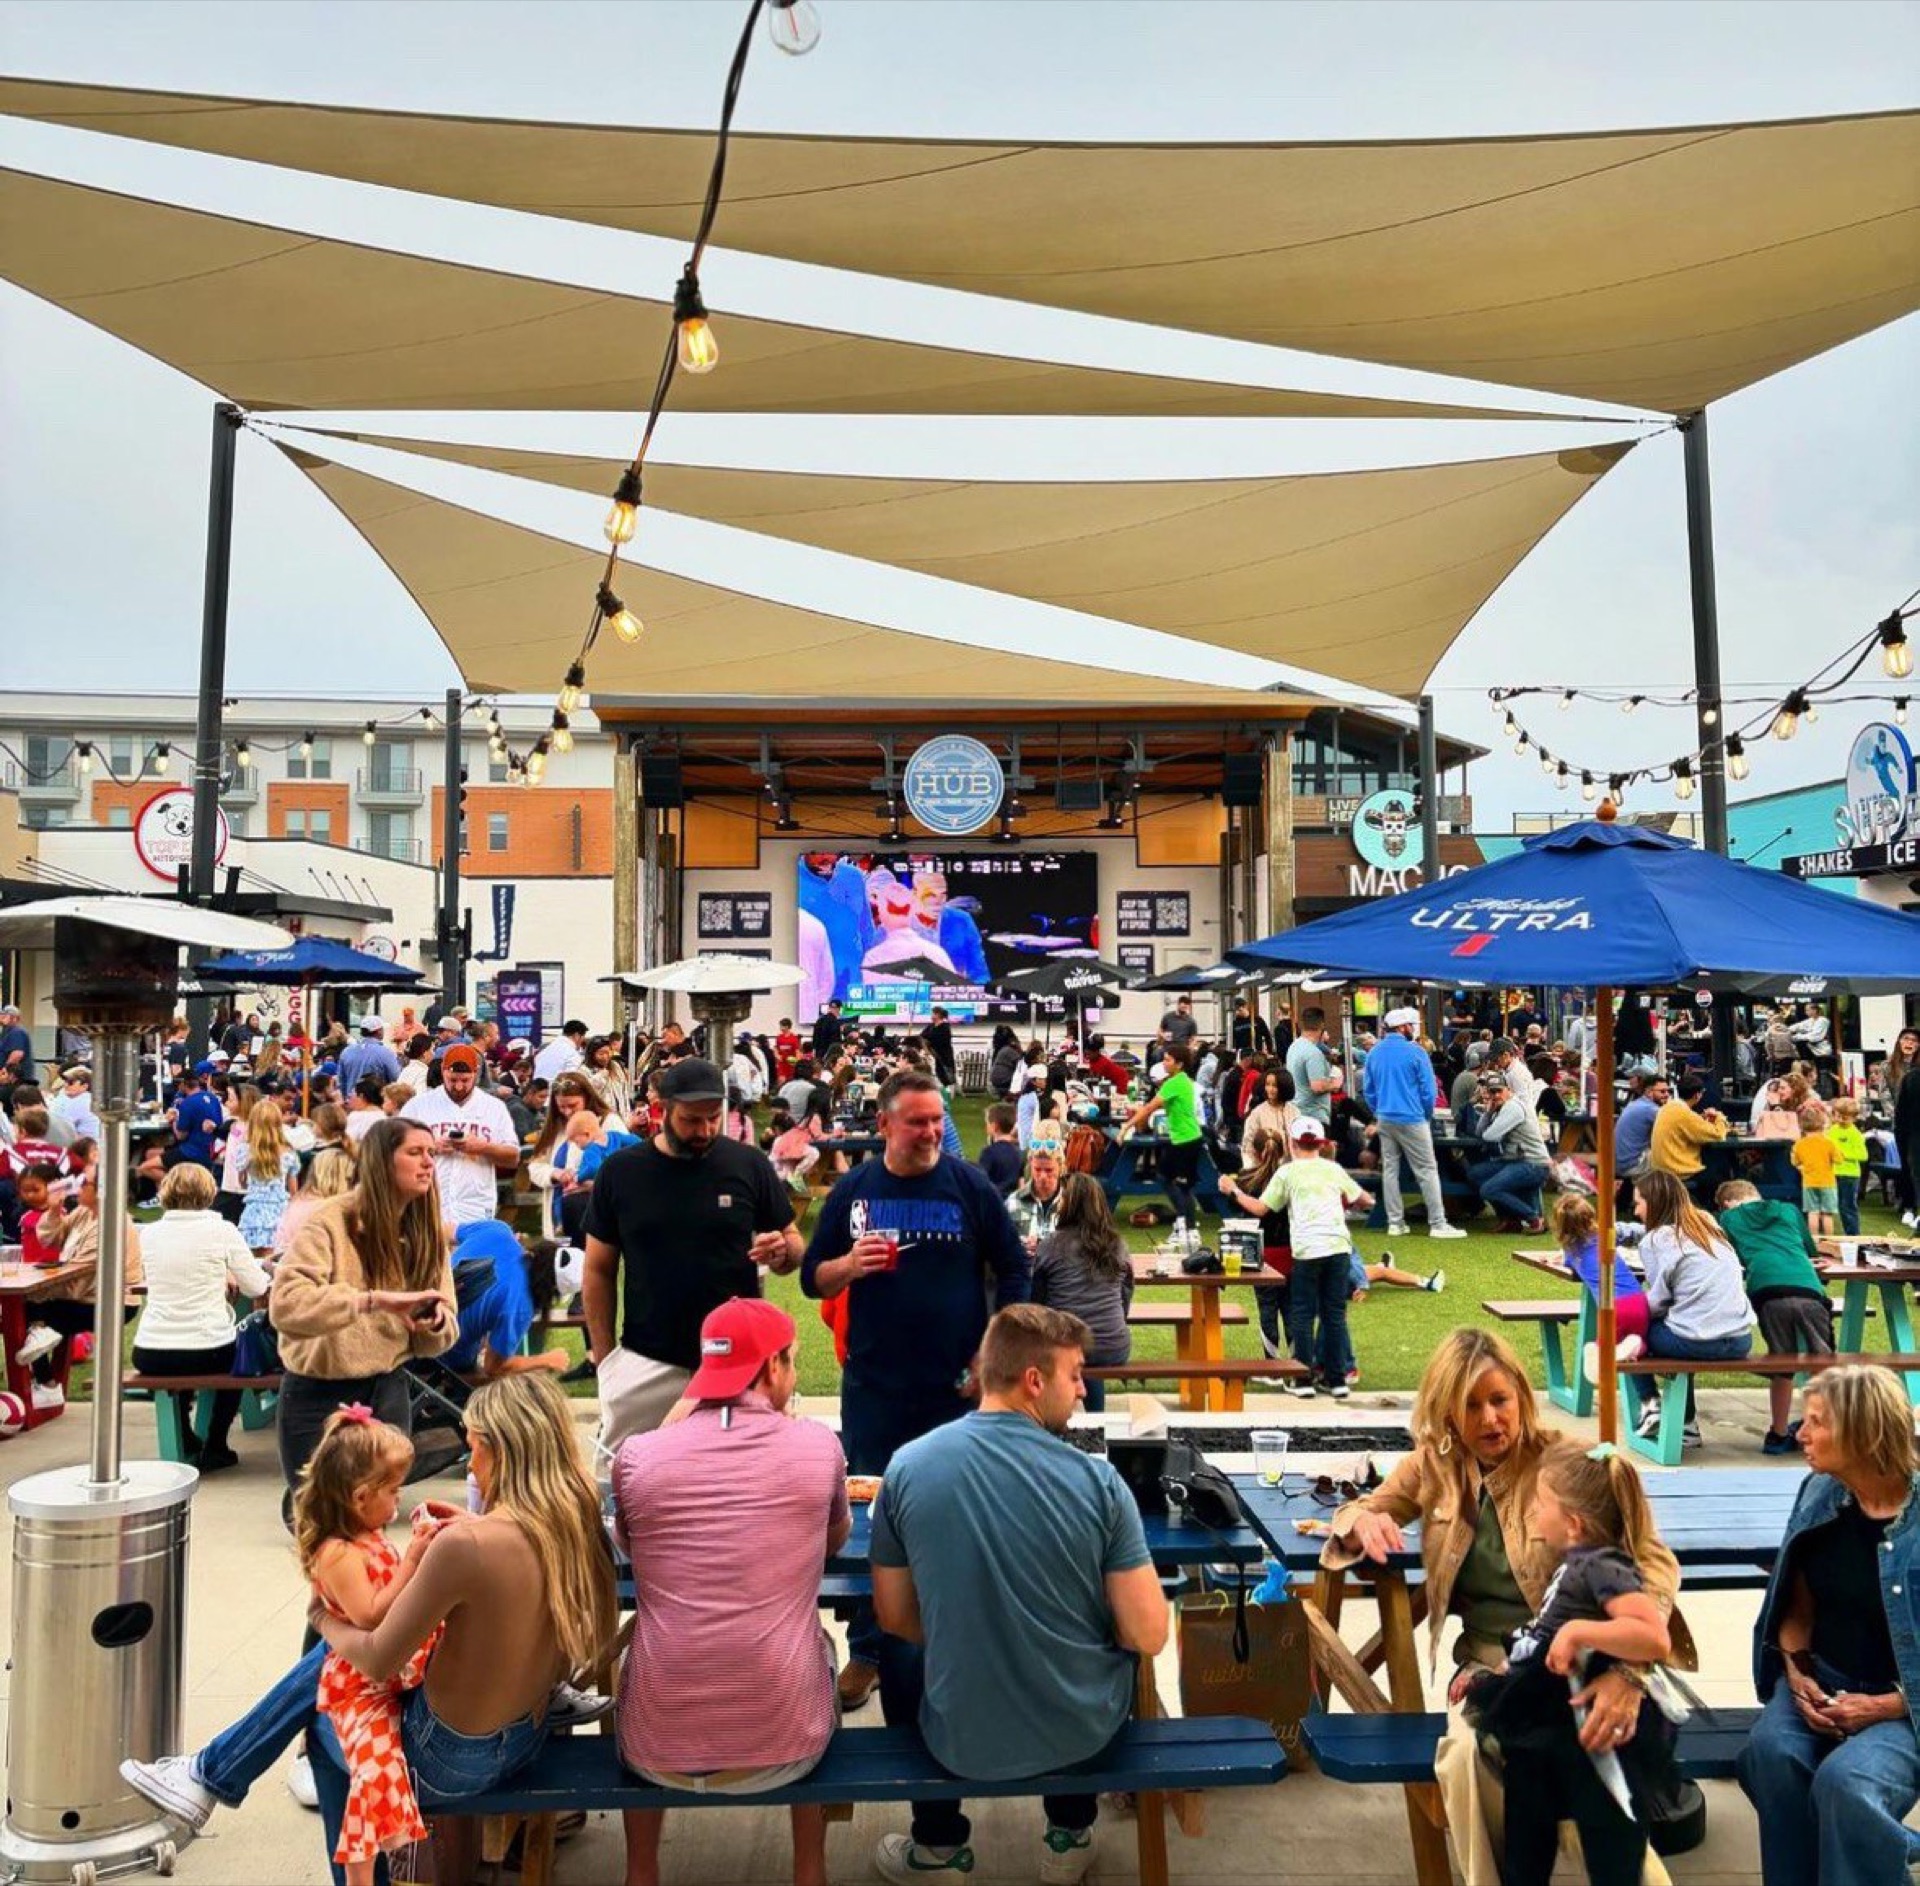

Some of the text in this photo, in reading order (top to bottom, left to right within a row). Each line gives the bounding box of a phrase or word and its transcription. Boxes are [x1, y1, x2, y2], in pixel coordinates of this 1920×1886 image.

[915, 774, 993, 796] HUB
[1329, 799, 1360, 811] LIVE
[1798, 841, 1917, 877] SHAKES ICE
[1410, 907, 1592, 931] ULTRA
